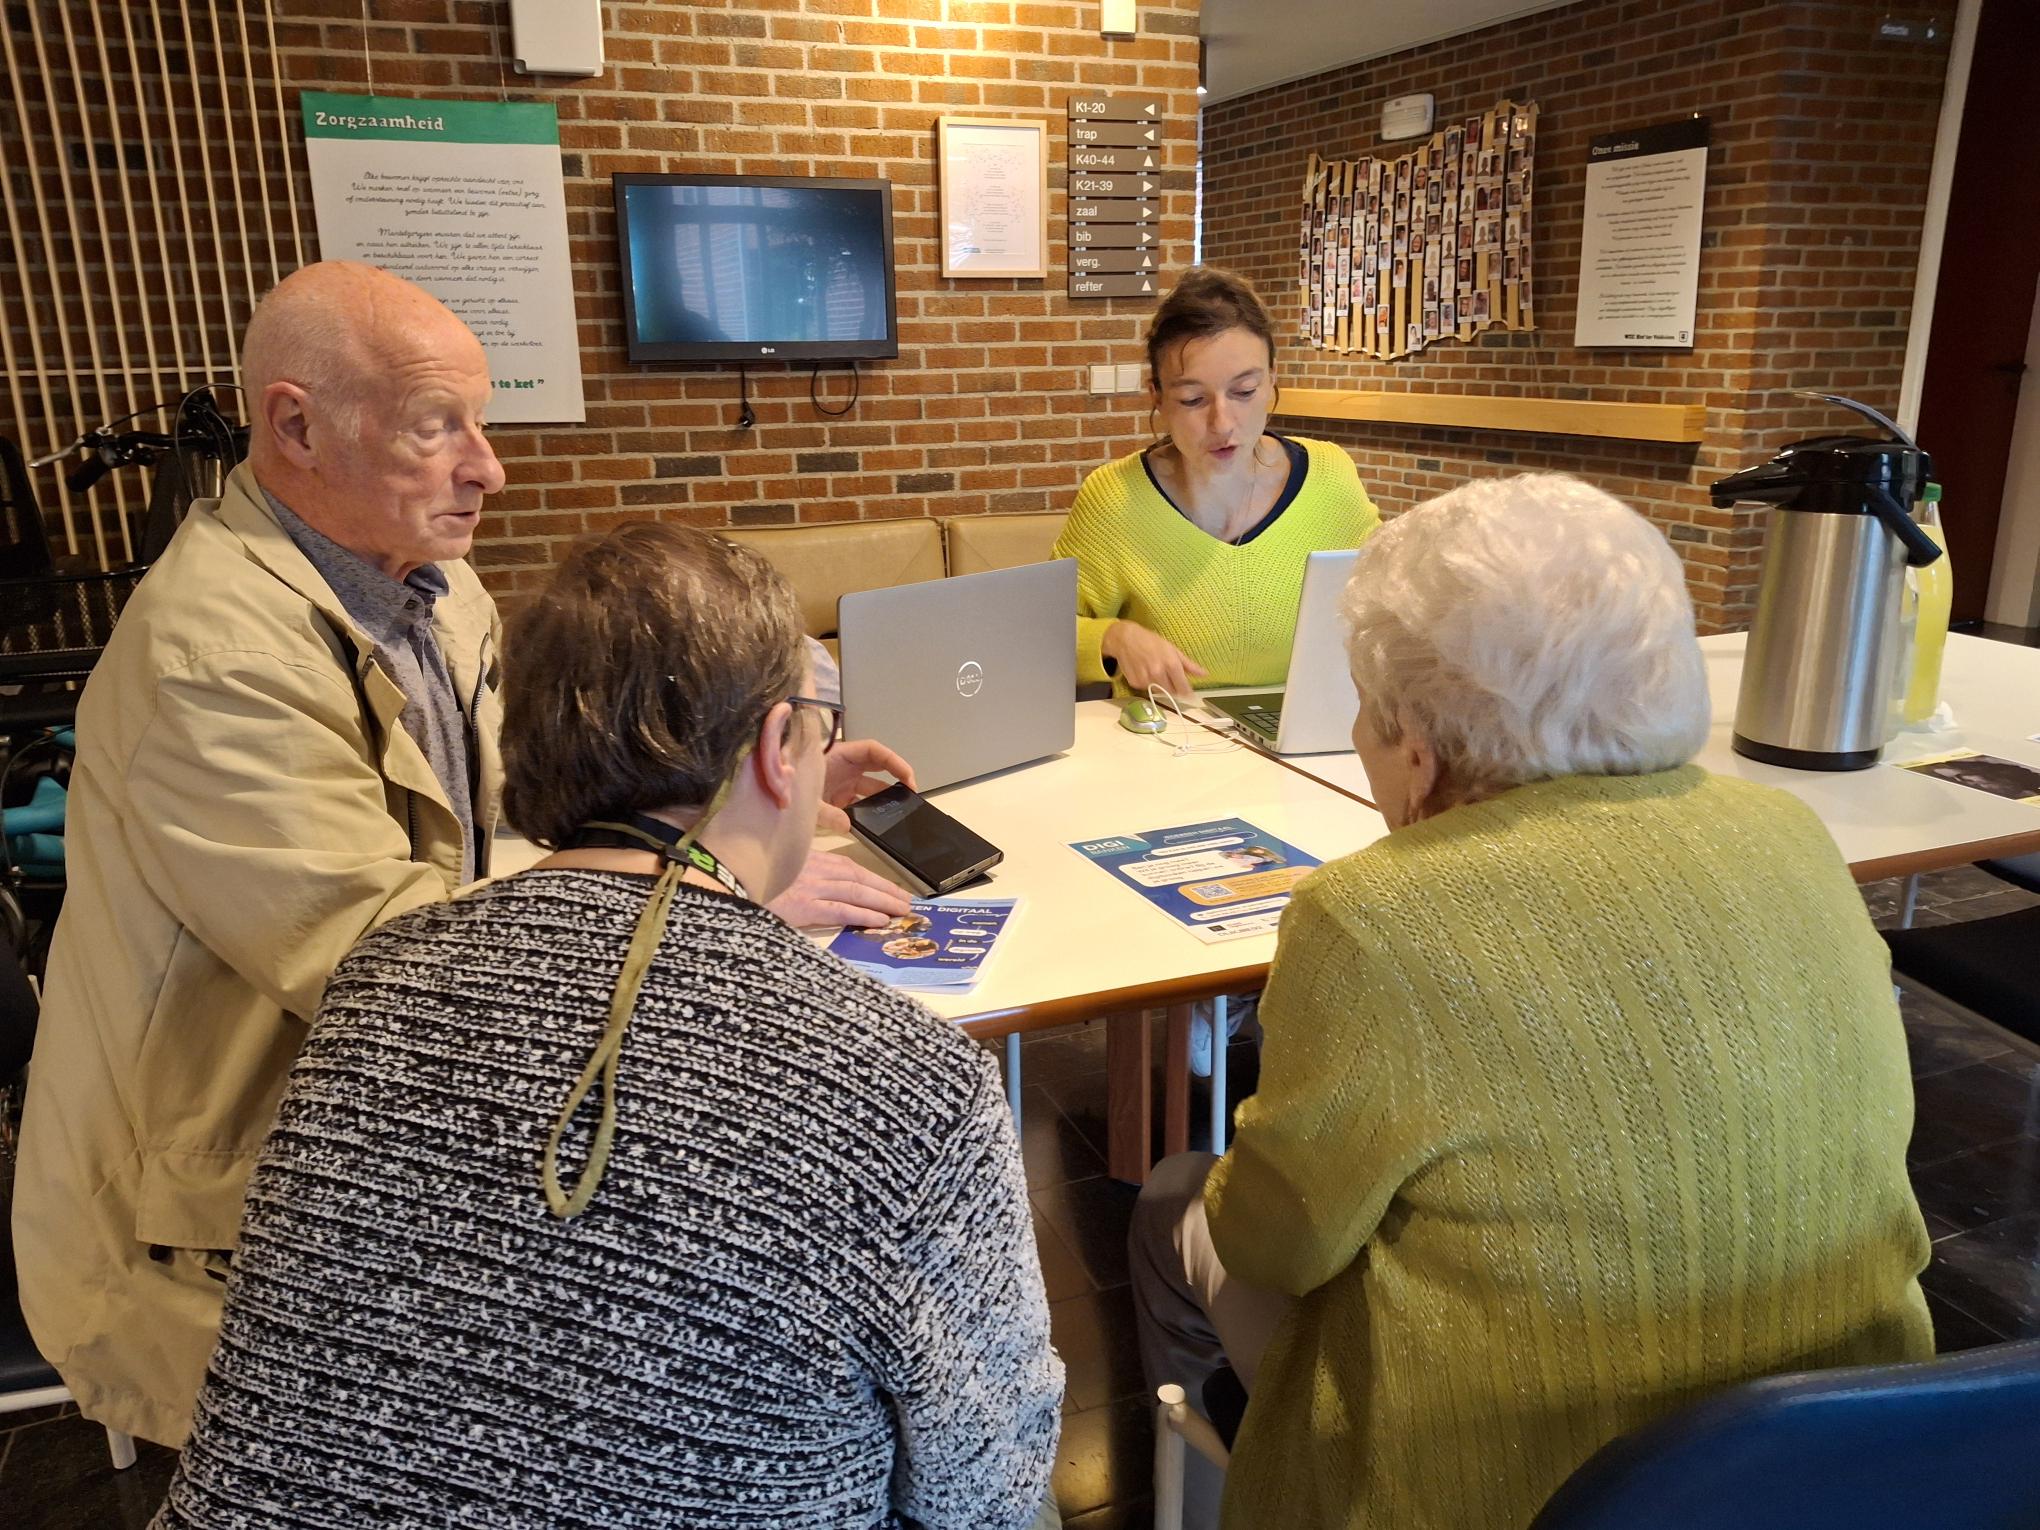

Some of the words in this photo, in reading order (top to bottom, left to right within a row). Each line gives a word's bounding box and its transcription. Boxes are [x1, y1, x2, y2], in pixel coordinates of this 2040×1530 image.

[1076, 102, 1105, 114] K1-20
[315, 111, 444, 132] Zorgzaamheid
[1076, 128, 1097, 141] trap
[1076, 154, 1115, 166] K40-44
[1076, 180, 1113, 192] K21-39
[1076, 205, 1098, 216] zaal
[1076, 231, 1092, 242] bib
[1076, 258, 1100, 269] verg.
[1076, 280, 1103, 292] refter
[1081, 840, 1124, 850] DIGI
